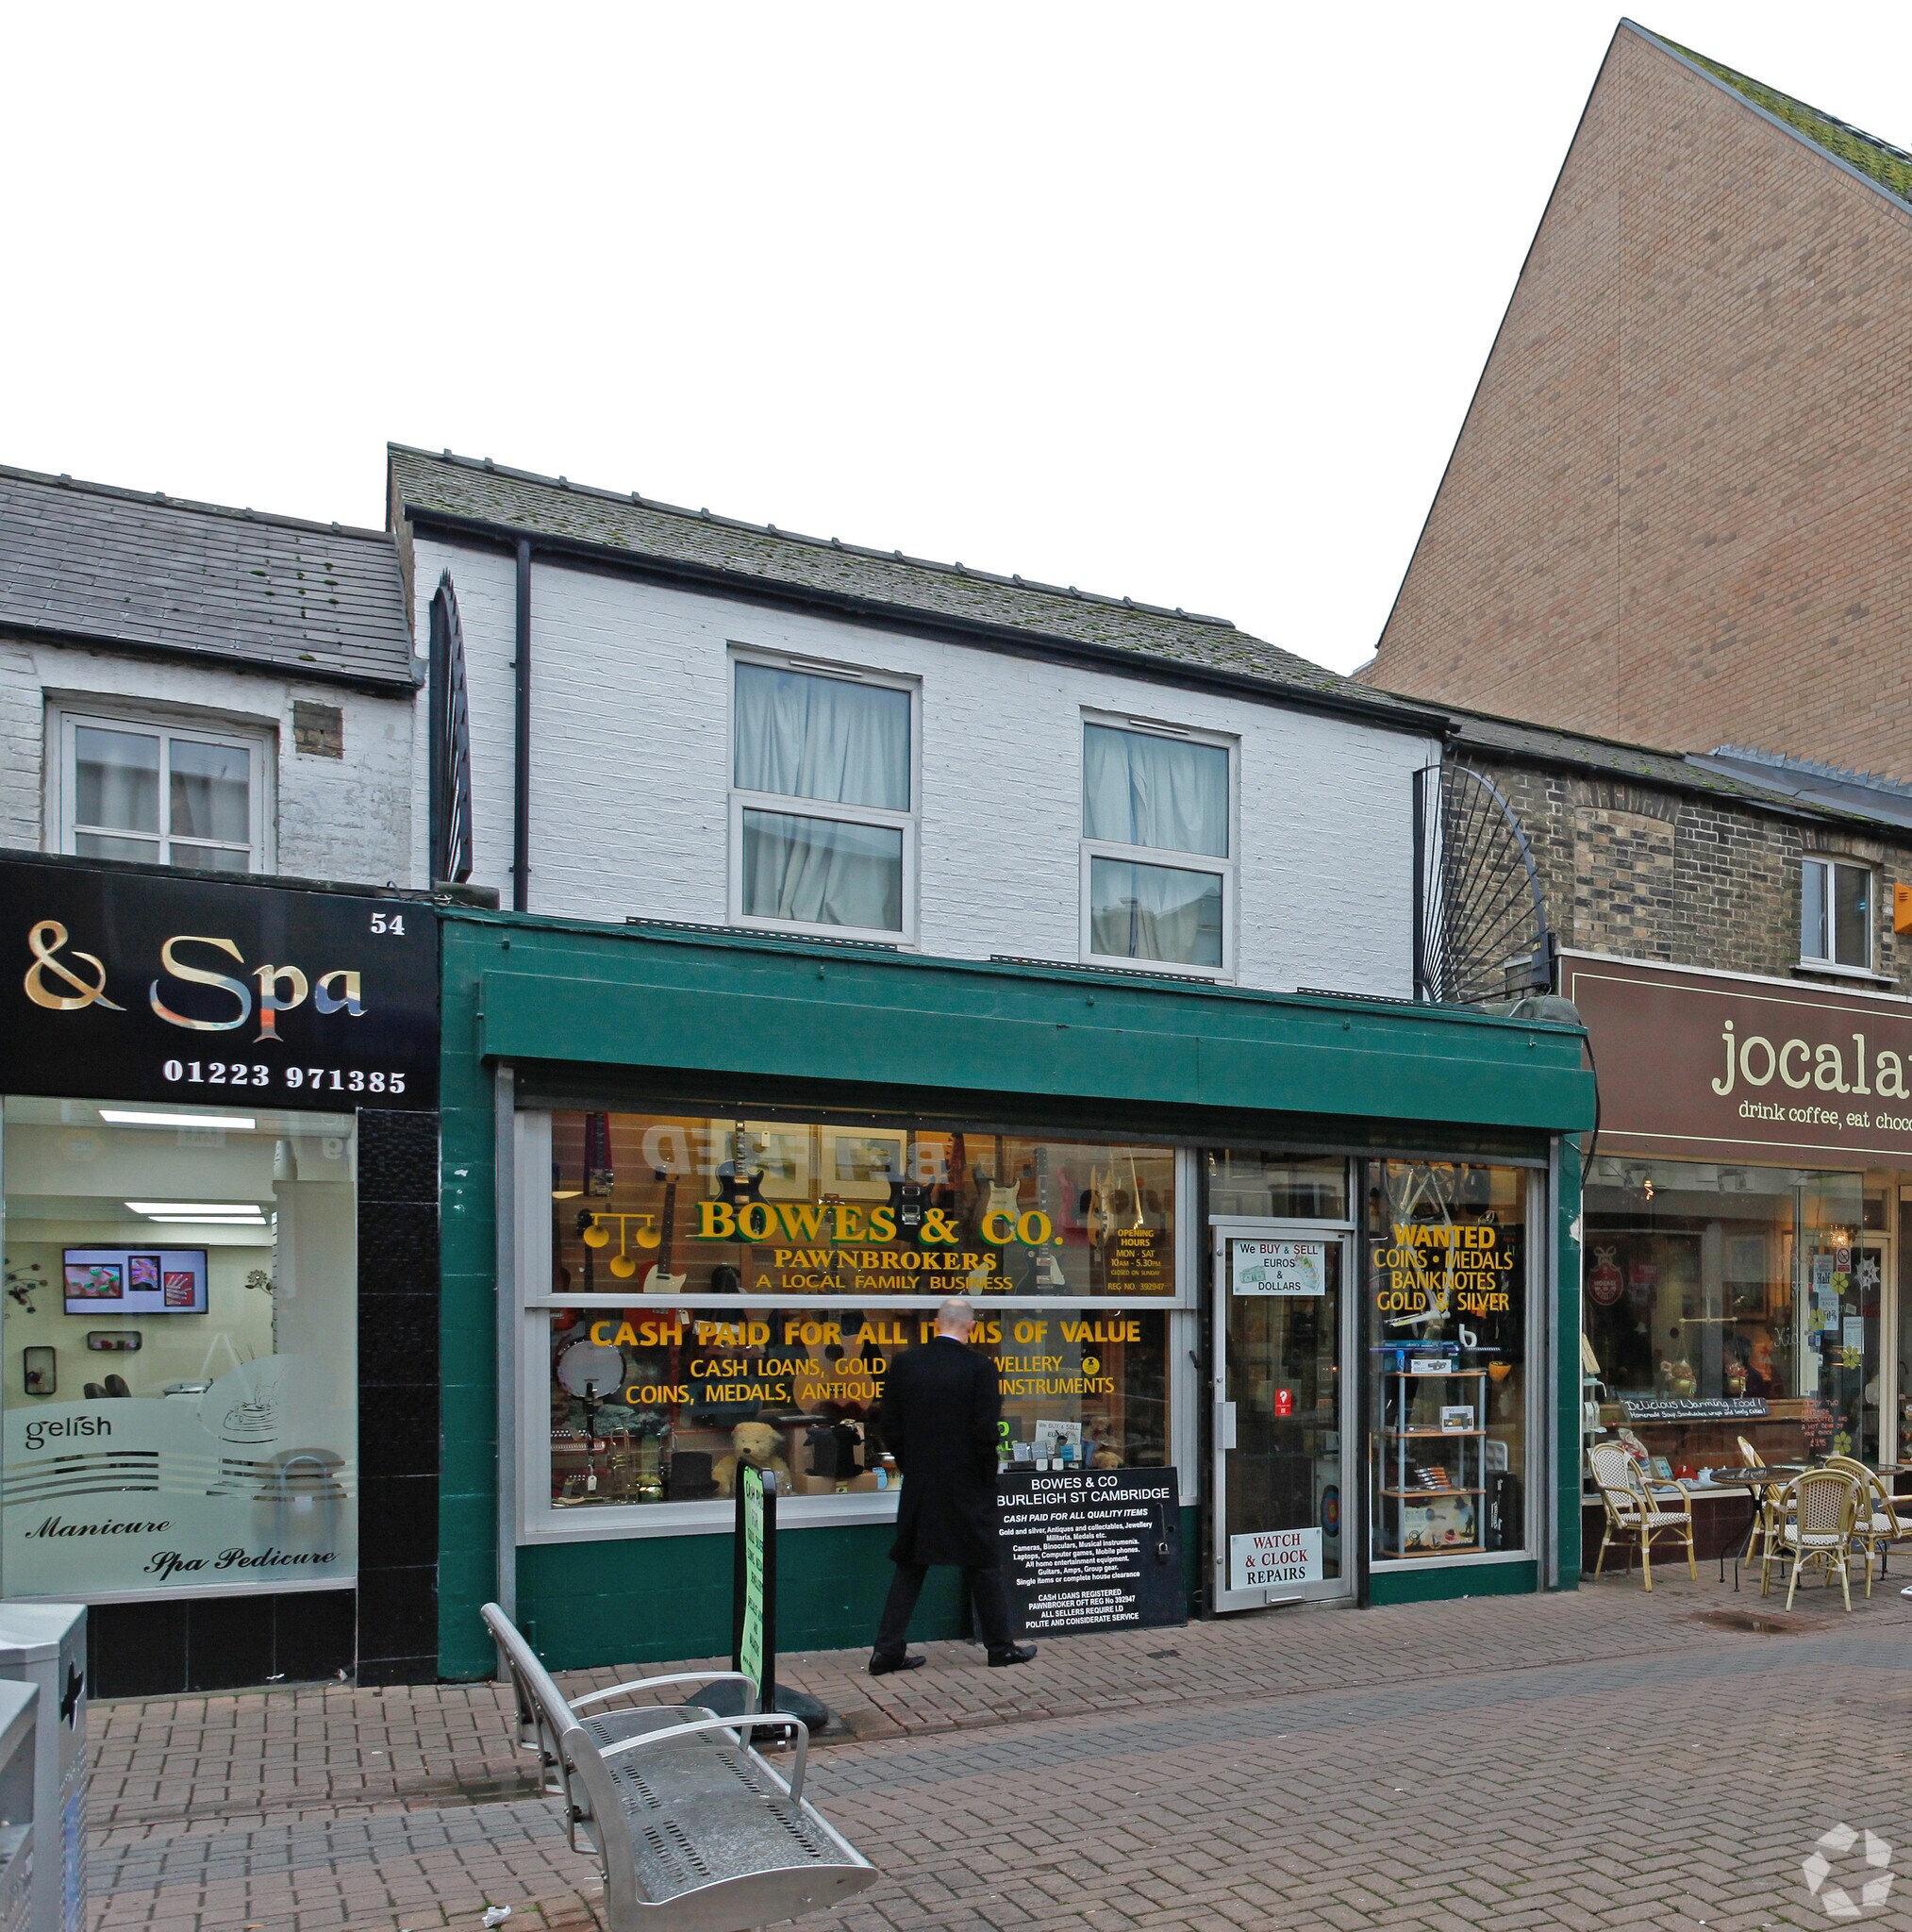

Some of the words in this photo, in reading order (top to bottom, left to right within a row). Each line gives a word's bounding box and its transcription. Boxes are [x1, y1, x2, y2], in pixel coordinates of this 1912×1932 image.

[370, 913, 405, 936] 54
[24, 920, 126, 1010] &
[150, 936, 368, 1043] Spa
[1711, 1020, 1912, 1100] jocala
[163, 1059, 270, 1086] 01223
[285, 1067, 406, 1093] 971385
[1738, 1101, 1786, 1122] drink
[1788, 1106, 1842, 1129] coffee,
[1846, 1111, 1870, 1128] eat
[695, 1201, 897, 1245] BOWES
[918, 1208, 959, 1245] &
[979, 1209, 1063, 1247] CO.
[1117, 1228, 1155, 1238] OPENING
[1393, 1224, 1496, 1249] WANTED
[1121, 1239, 1151, 1247] HOURS
[1239, 1243, 1255, 1254] We
[1259, 1243, 1281, 1255] BUY
[1284, 1245, 1290, 1255] &
[1293, 1244, 1319, 1255] SELL
[773, 1249, 997, 1272] PAWNBROKERS
[1116, 1249, 1136, 1257] MON
[1141, 1250, 1156, 1258] SAT
[1373, 1248, 1428, 1269] COINS
[1445, 1251, 1514, 1270] MEDALS
[1264, 1258, 1296, 1268] EUROS
[756, 1274, 772, 1289] A
[783, 1274, 845, 1289] LOCAL
[855, 1275, 920, 1290] FAMILY
[930, 1276, 1013, 1291] BUSINESS
[1276, 1271, 1283, 1279] &
[1391, 1270, 1497, 1291] BANKNOTES
[1258, 1281, 1301, 1291] DOLLARS
[1376, 1291, 1426, 1311] GOLD
[1456, 1291, 1509, 1312] SILVER
[590, 1321, 683, 1346] CASH
[698, 1321, 770, 1345] PAID
[784, 1321, 842, 1345] FOR
[856, 1321, 908, 1345] ALL
[920, 1321, 1003, 1344] ITMS
[1014, 1321, 1048, 1344] OF
[1060, 1321, 1141, 1343] VALUE
[690, 1358, 748, 1377] CASH
[757, 1358, 825, 1378] LOANS,
[625, 1385, 695, 1406] COINS,
[706, 1383, 791, 1404] MEDALS,
[998, 1377, 1115, 1395] INSTRUMENTS
[1624, 1399, 1678, 1412] Delicious
[1679, 1400, 1730, 1412] Warming
[25, 1416, 112, 1450] gelish
[1031, 1477, 1082, 1491] BOWES
[1085, 1476, 1095, 1489] &
[1098, 1475, 1118, 1488] CO
[997, 1492, 1067, 1507] BURLEIGH
[1070, 1492, 1088, 1504] ST
[1090, 1487, 1171, 1503] CAMBRIDGE
[1003, 1514, 1028, 1524] CASH
[1028, 1513, 1049, 1523] PAID
[1050, 1512, 1069, 1521] FOR
[1070, 1511, 1086, 1520] ALL
[1087, 1509, 1124, 1520] QUALITY
[1123, 1507, 1149, 1517] ITEMS
[25, 1515, 176, 1540] Manicure
[1046, 1524, 1074, 1534] Antiques
[1124, 1521, 1153, 1529] Jewellery
[1079, 1540, 1103, 1548] Musical
[1253, 1533, 1302, 1550] WATCH
[142, 1550, 208, 1581] Spa
[213, 1546, 342, 1572] Pedicure
[1041, 1551, 1072, 1559] Computer
[1054, 1557, 1096, 1566] entertainment
[1245, 1555, 1255, 1568] &
[1261, 1549, 1308, 1566] CLOCK
[1084, 1565, 1104, 1574] Group
[1246, 1566, 1306, 1585] REPAIRS
[1016, 1577, 1036, 1587] Single
[1063, 1574, 1091, 1583] complete
[1111, 1571, 1140, 1579] clearance
[1028, 1599, 1075, 1610] PAWNBROKER
[1075, 1599, 1089, 1607] OFT
[1089, 1597, 1105, 1606] REG
[1038, 1593, 1056, 1602] CASH
[1057, 1591, 1081, 1601] LOANS
[1081, 1589, 1122, 1599] REGISTERED
[1025, 1620, 1050, 1629] POLITE
[1050, 1619, 1065, 1627] AND
[1065, 1614, 1111, 1625] CONSIDERATE
[1111, 1612, 1139, 1622] SERVICE
[1040, 1610, 1055, 1619] ALL
[1055, 1607, 1085, 1618] SELLERS
[1086, 1606, 1114, 1615] REQUIRE
